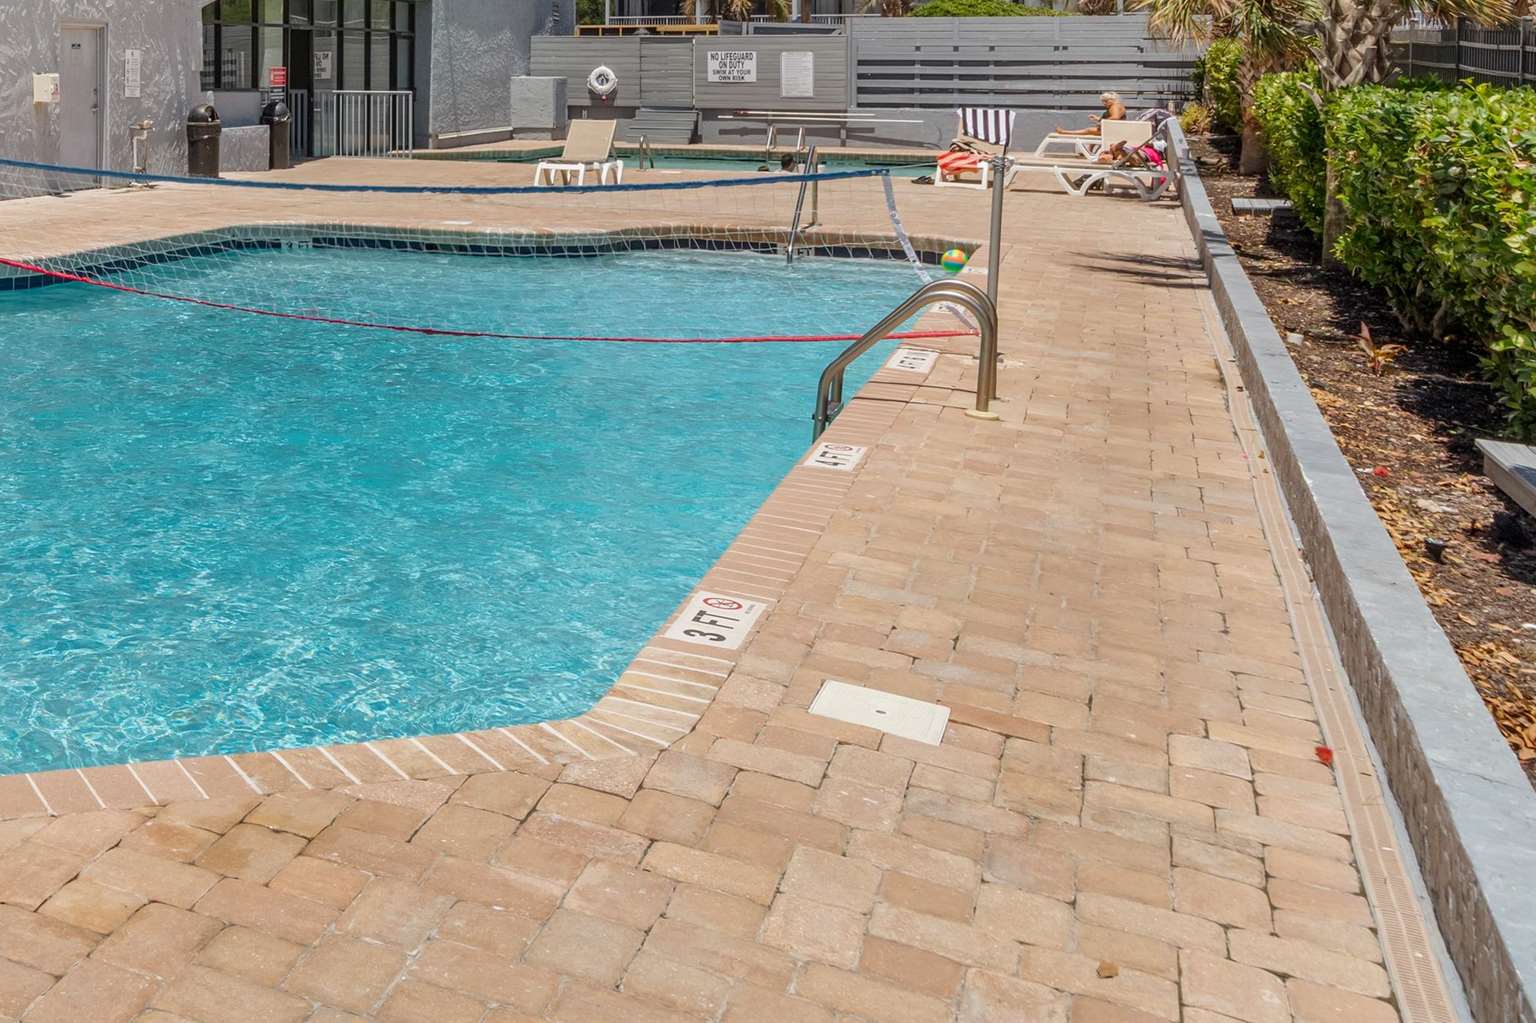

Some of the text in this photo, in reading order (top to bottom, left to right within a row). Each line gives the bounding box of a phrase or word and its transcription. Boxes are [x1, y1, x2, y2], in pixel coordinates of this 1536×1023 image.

[710, 52, 754, 61] NO LIFEGUARD
[718, 61, 745, 69] ON DUTY
[819, 451, 852, 461] FT
[683, 609, 740, 642] 3 FT
